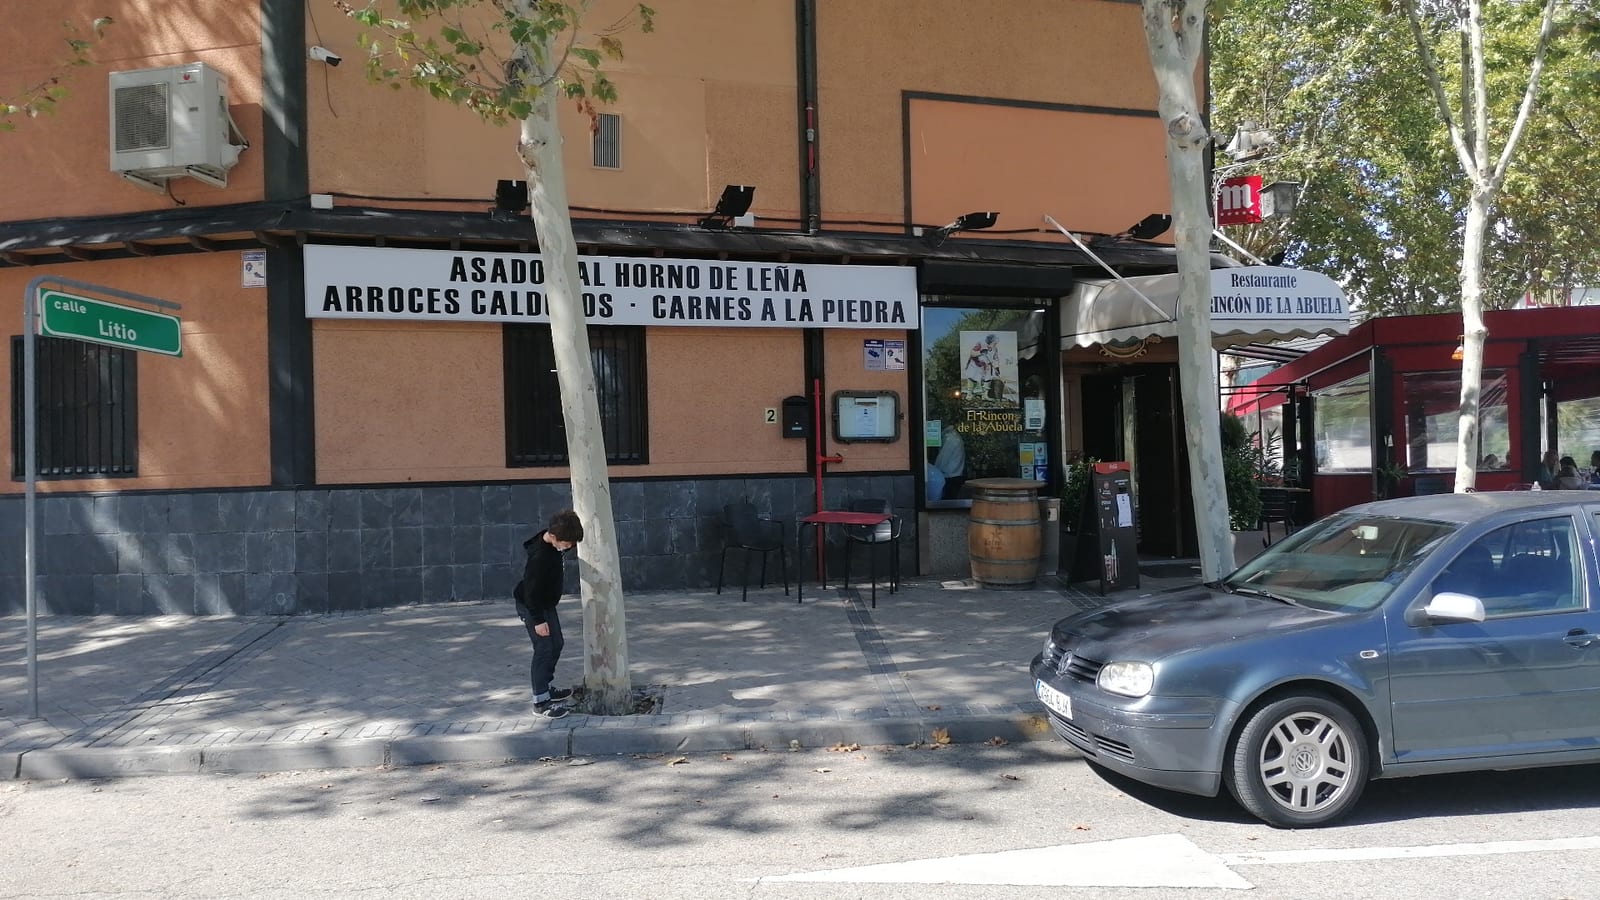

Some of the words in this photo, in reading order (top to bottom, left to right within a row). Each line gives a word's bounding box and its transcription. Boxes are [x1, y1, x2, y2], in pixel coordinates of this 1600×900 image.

[450, 256, 544, 284] ASADO
[615, 262, 700, 290] HORNO
[709, 266, 738, 291] DE
[746, 265, 808, 293] LEÑA
[1231, 273, 1297, 288] Restaurante
[54, 300, 87, 314] calle
[322, 285, 460, 314] ARROCES
[471, 289, 613, 318] CALDOS
[652, 294, 751, 321] CARNES
[761, 298, 776, 322] A
[785, 298, 814, 322] LA
[822, 299, 906, 323] PIEDRA
[1255, 296, 1272, 314] DE
[1276, 296, 1293, 314] LA
[1296, 296, 1342, 314] ABUELA
[99, 319, 137, 341] Lítio
[767, 409, 775, 422] 2
[967, 410, 977, 421] El
[957, 421, 969, 432] de
[972, 421, 982, 432] la
[984, 420, 1023, 432] Abuela
